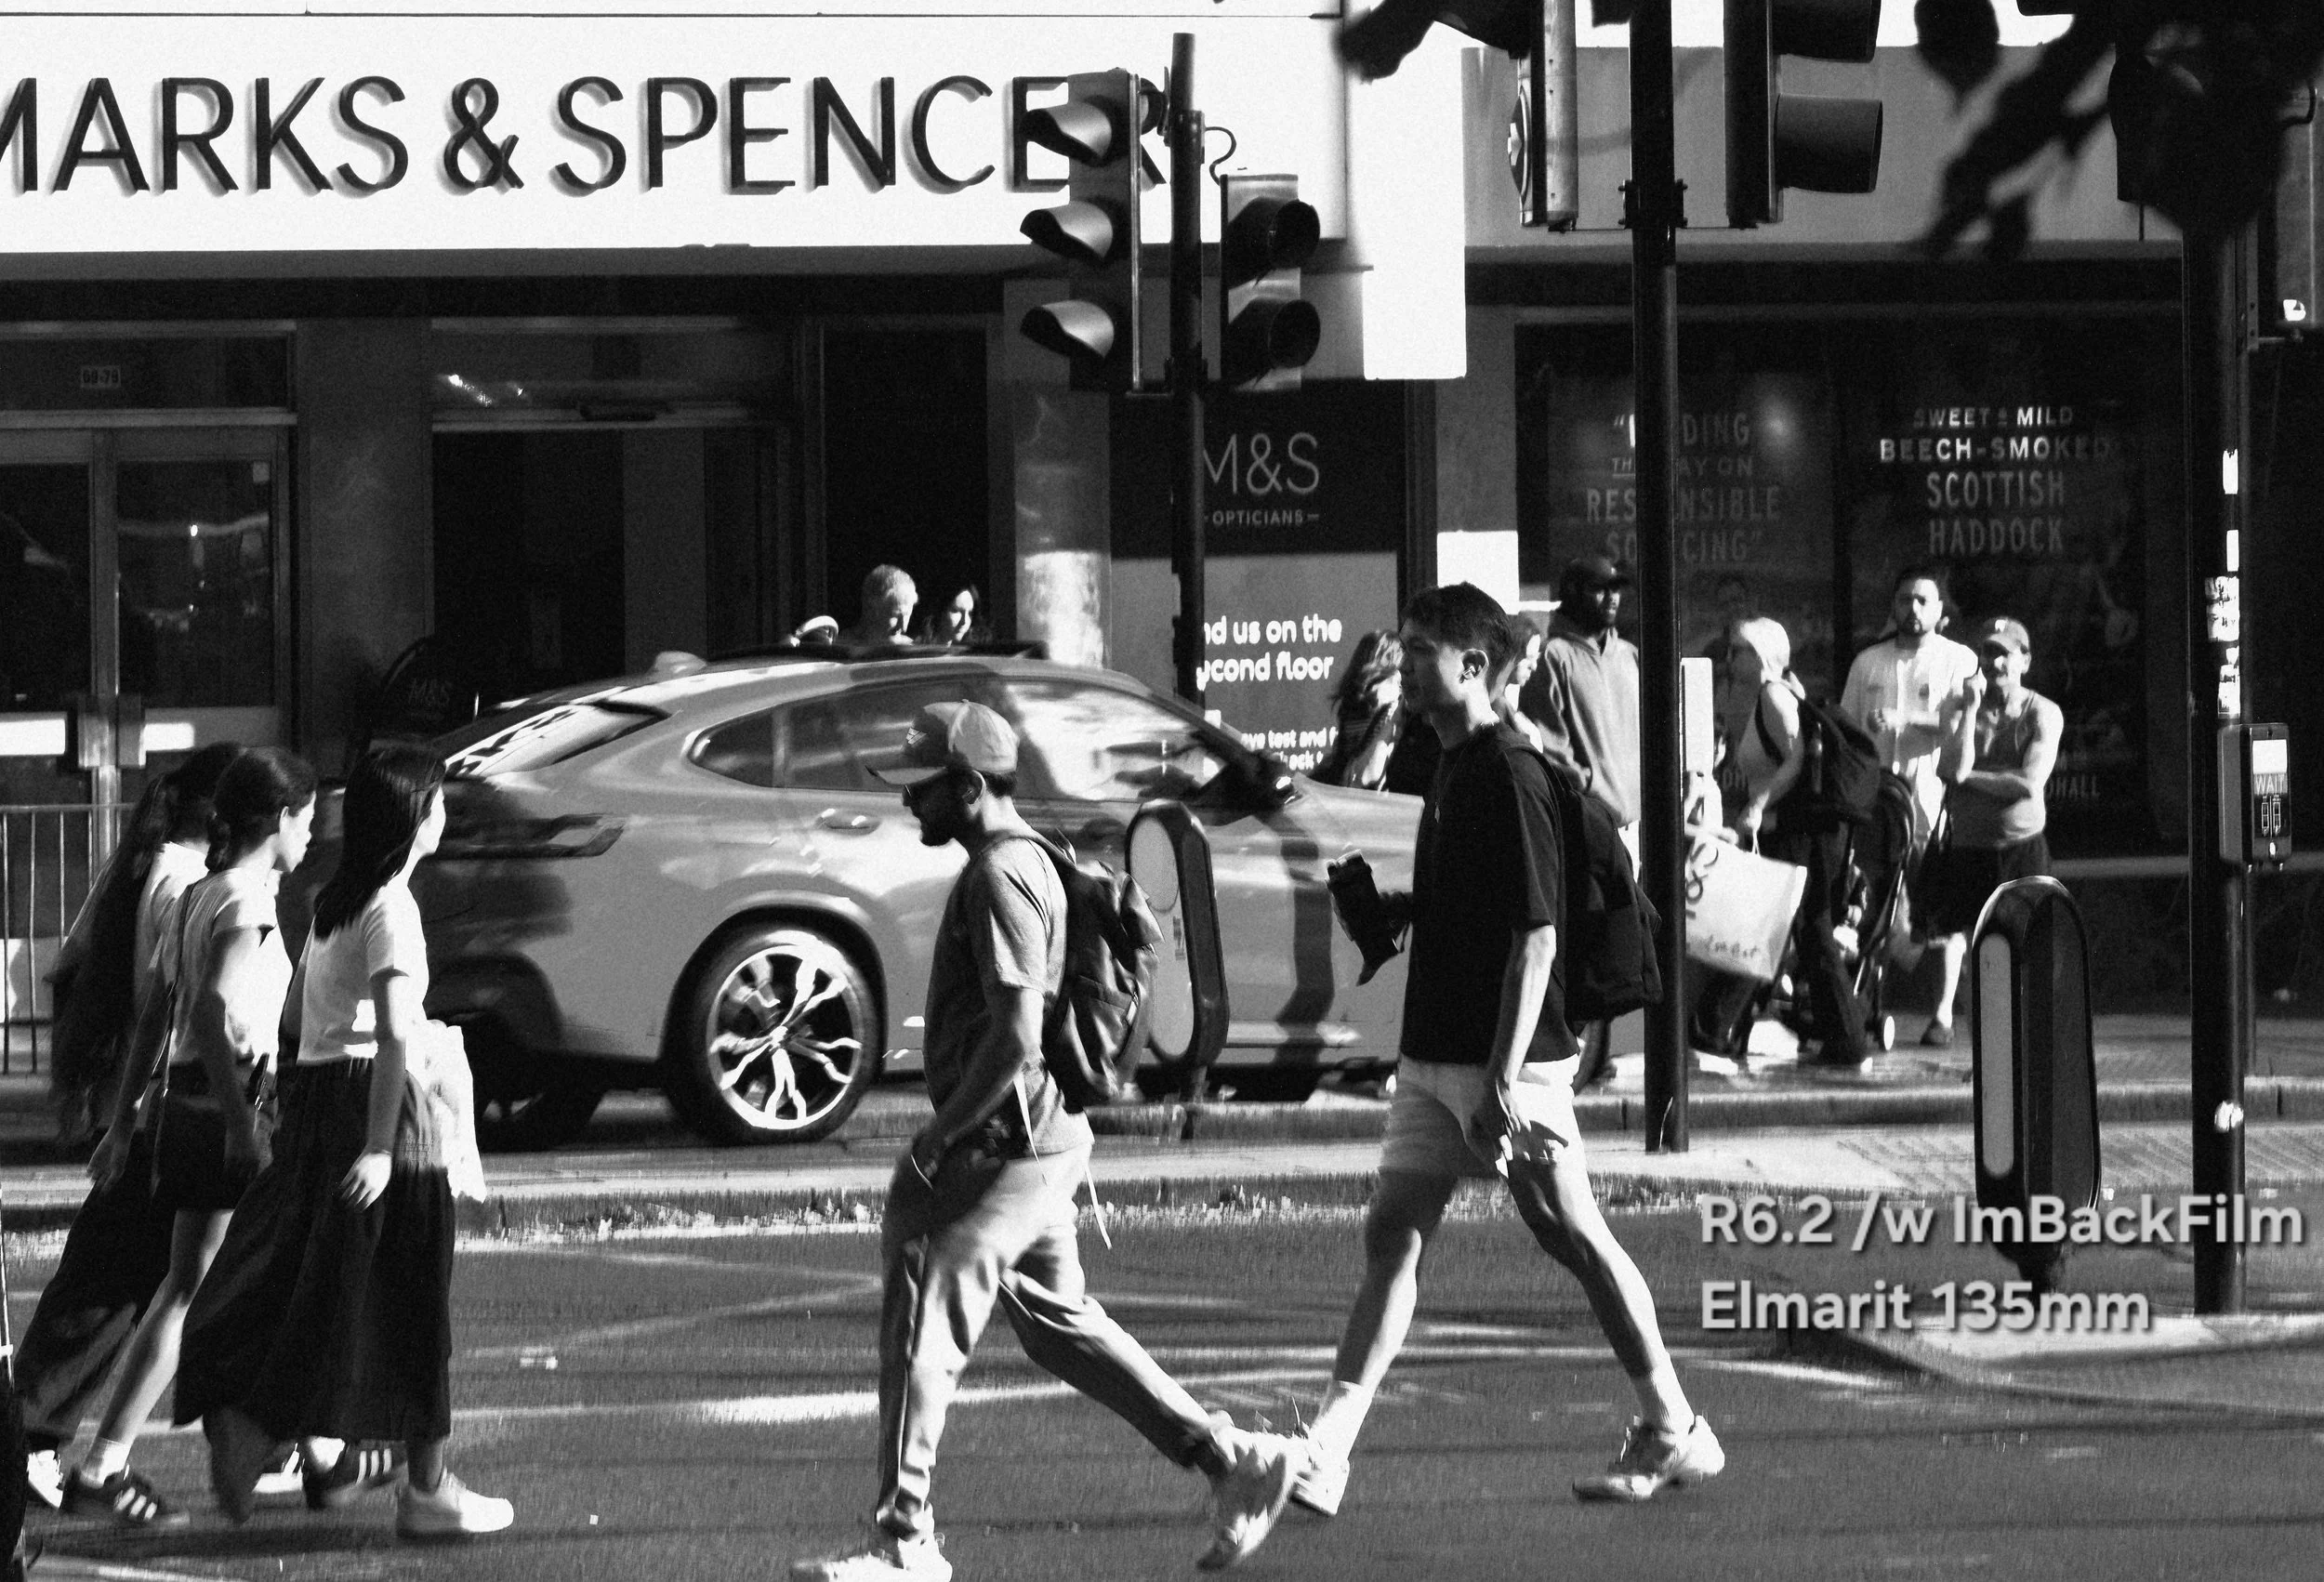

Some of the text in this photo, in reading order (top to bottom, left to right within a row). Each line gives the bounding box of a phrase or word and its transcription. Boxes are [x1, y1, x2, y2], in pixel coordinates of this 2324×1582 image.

[442, 76, 525, 191] &
[1913, 406, 1990, 428] SWEET
[2015, 405, 2073, 428] MILD
[1879, 435, 2112, 462] BEECH-SMOKED
[1926, 469, 2065, 508] SCOTTISH
[1212, 508, 1303, 526] OPTICIANS
[1929, 515, 2064, 556] HADDOCK
[1233, 621, 1261, 644] us
[1266, 620, 1297, 644] on
[1302, 613, 1342, 643] the
[1276, 651, 1334, 680] floor
[2253, 773, 2286, 795] WAIT
